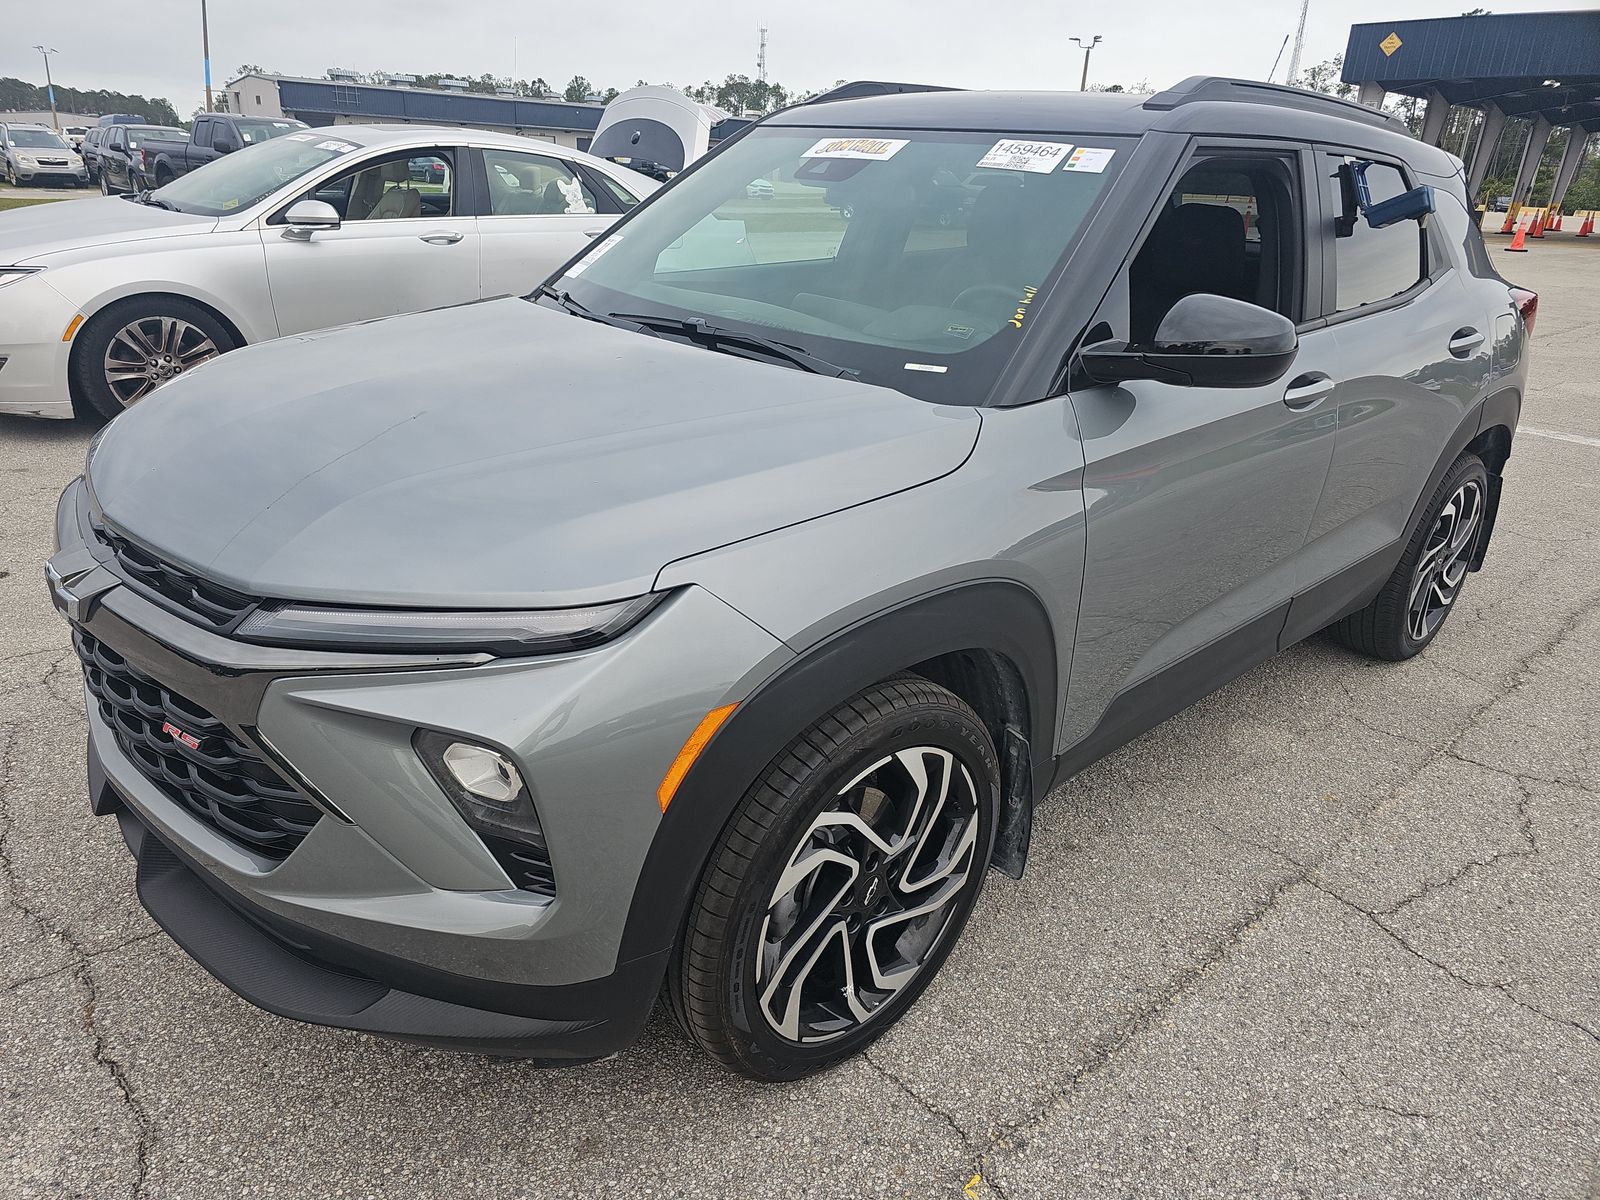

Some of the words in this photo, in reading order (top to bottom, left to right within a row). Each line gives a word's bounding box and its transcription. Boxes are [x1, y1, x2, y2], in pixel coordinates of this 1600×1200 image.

[994, 143, 1062, 157] 1459464
[1008, 307, 1026, 328] Jon
[1019, 285, 1038, 304] hall
[163, 722, 201, 750] RS
